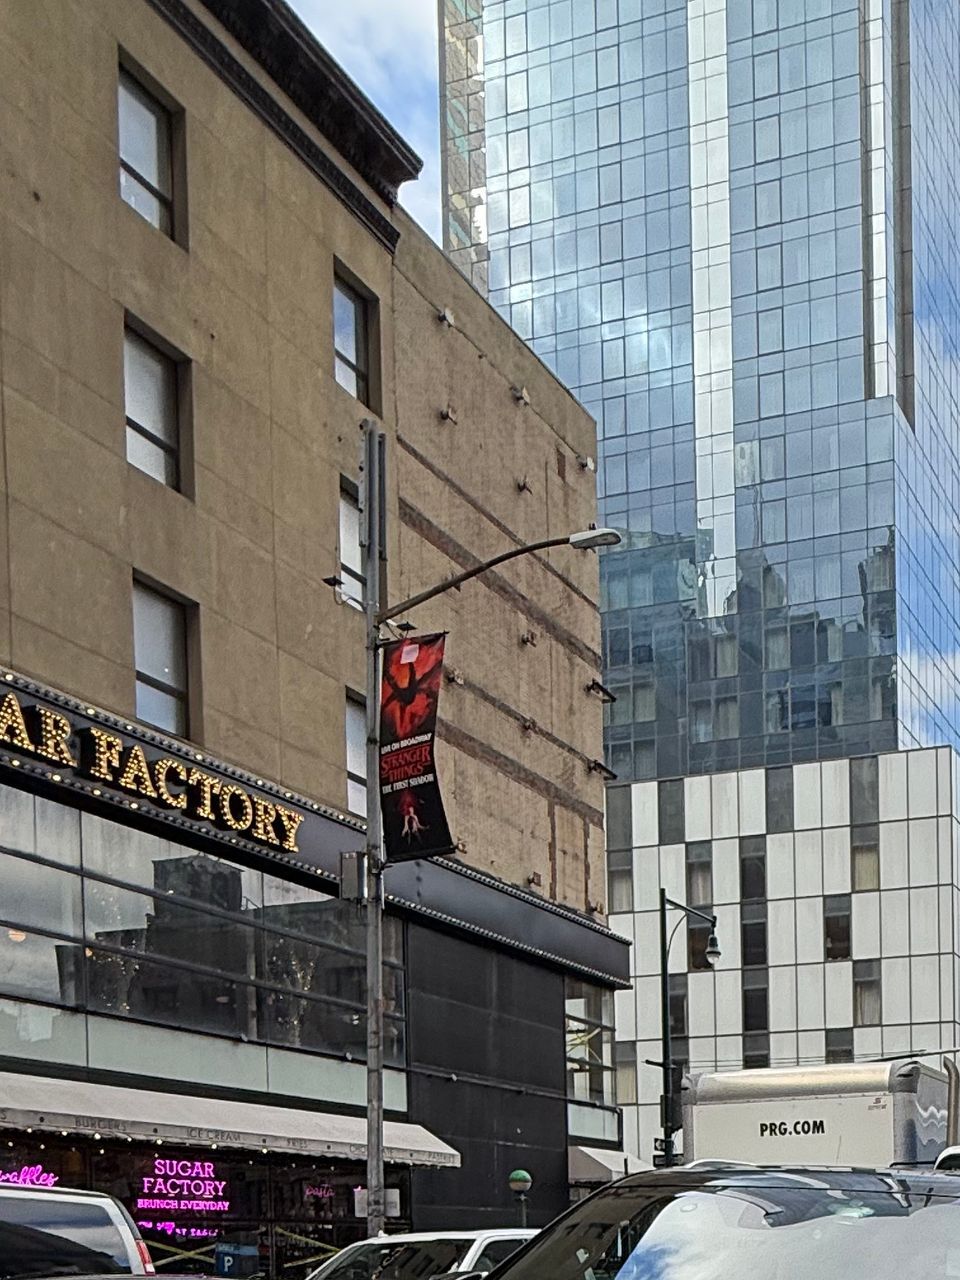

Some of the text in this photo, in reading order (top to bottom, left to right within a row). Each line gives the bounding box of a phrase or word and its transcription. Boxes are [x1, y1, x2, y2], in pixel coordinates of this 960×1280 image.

[391, 742, 400, 751] ON
[400, 732, 432, 748] BROADWAY
[381, 745, 431, 777] STRANGER
[0, 692, 304, 852] AR FACTORY
[390, 762, 424, 783] THINGS
[382, 773, 434, 794] THE FIRST SHADOW
[75, 1116, 127, 1131] BURGERS
[760, 1120, 825, 1137] PRG.COM
[154, 1159, 215, 1178] SUGAR
[142, 1177, 227, 1197] FACTORY
[137, 1199, 230, 1211] BRUNCH EVERYDAY
[224, 1256, 233, 1272] P
